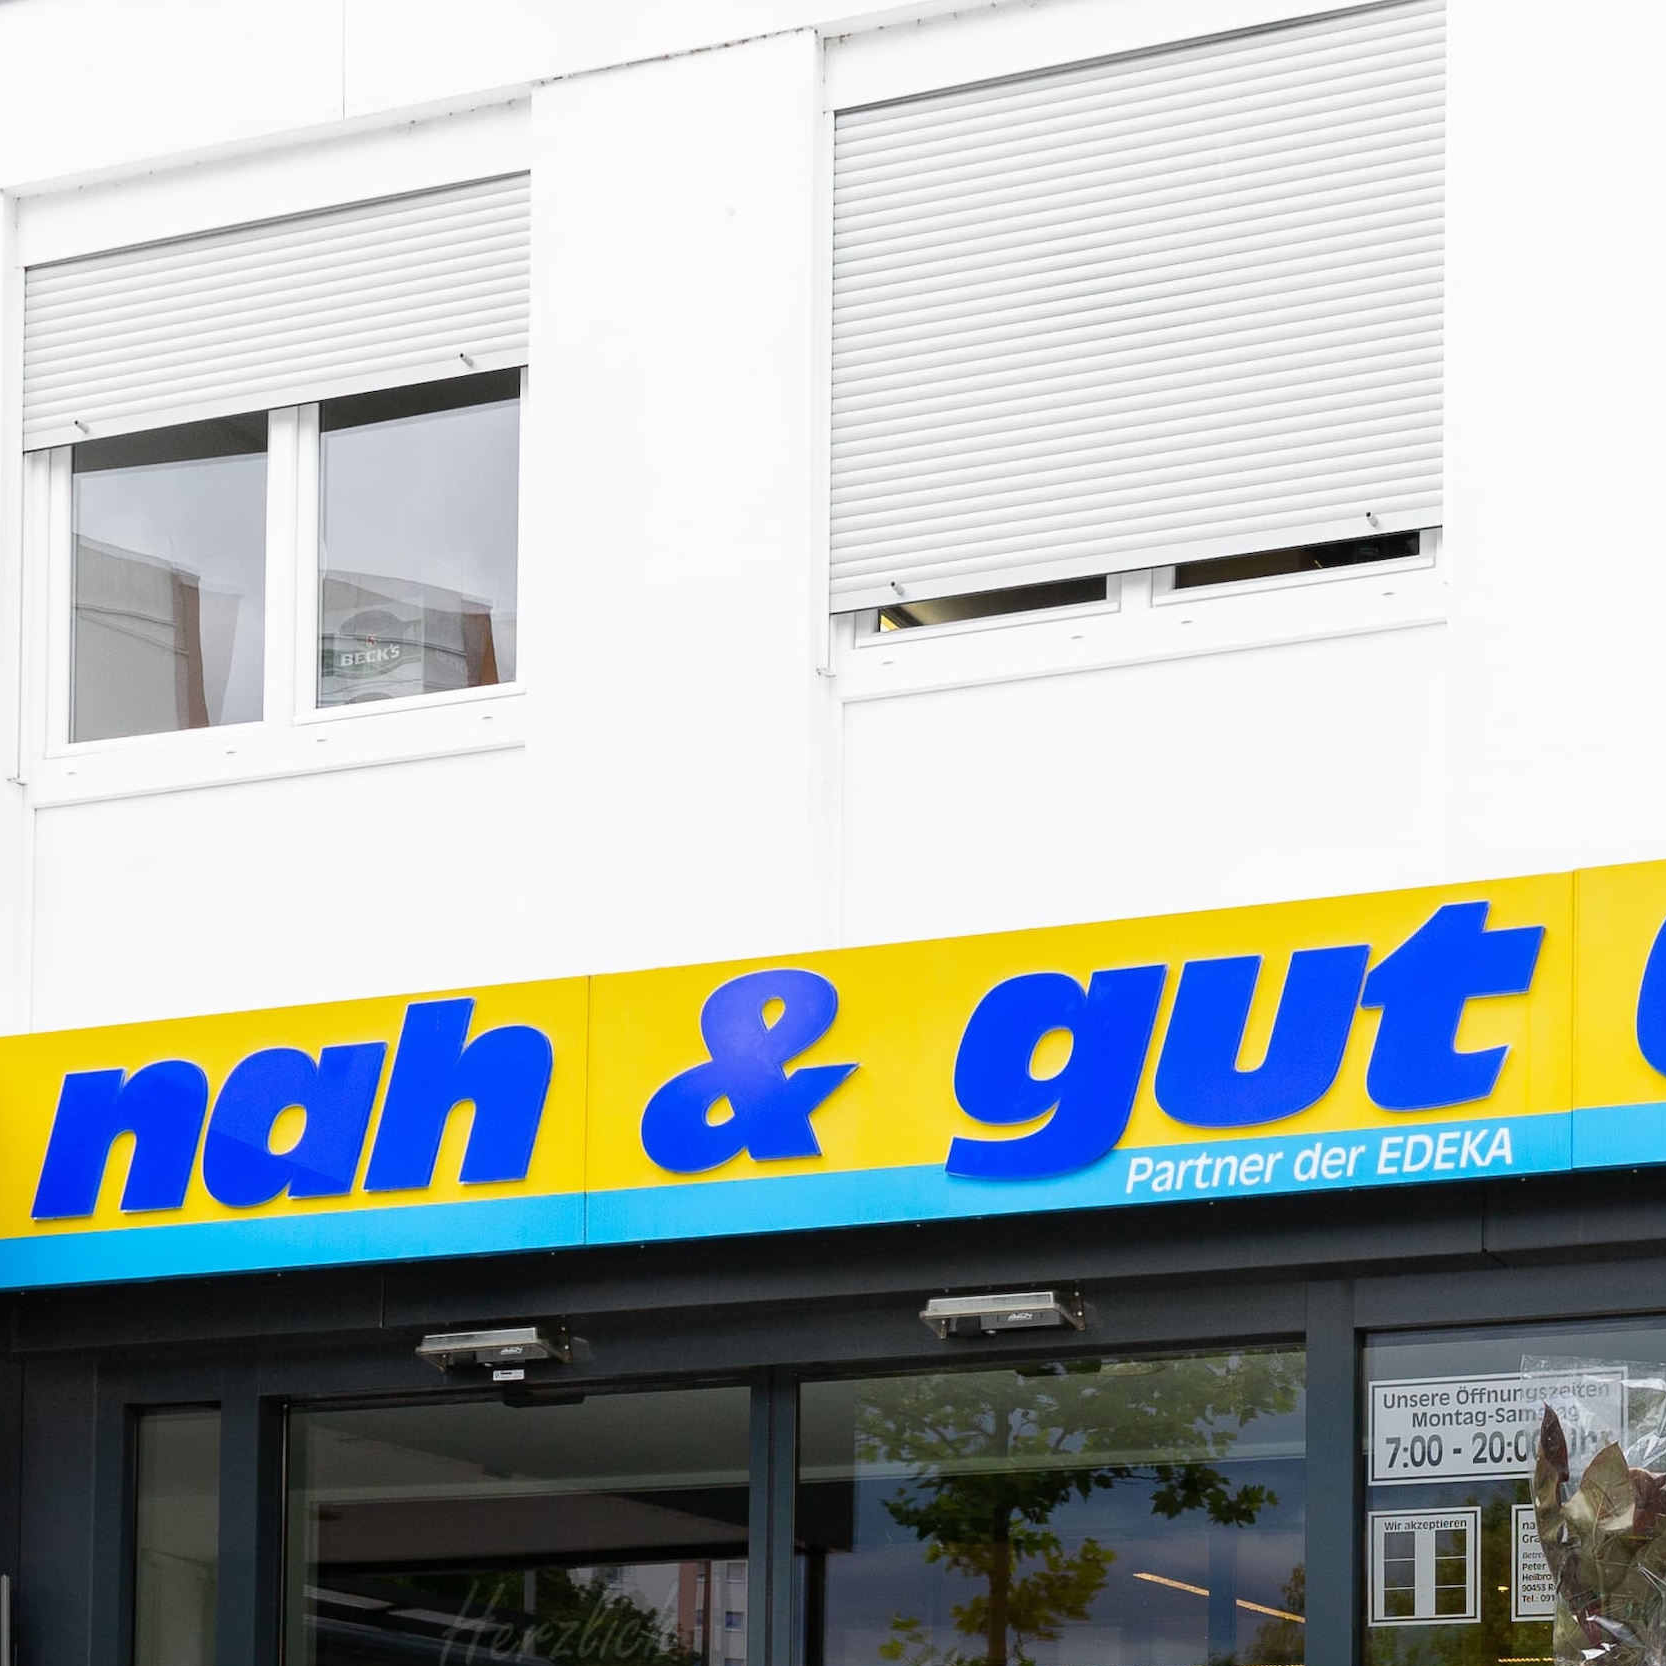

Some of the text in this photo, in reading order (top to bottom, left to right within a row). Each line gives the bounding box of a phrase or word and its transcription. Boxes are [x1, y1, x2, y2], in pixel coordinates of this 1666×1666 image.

[32, 996, 554, 1221] nah
[639, 968, 859, 1176] &
[945, 901, 1546, 1181] gut
[1125, 1127, 1513, 1194] Partner der EDEKA
[1383, 1380, 1610, 1409] Unsere Öffnungszeiten
[1412, 1405, 1580, 1428] Montag-Samag
[1385, 1434, 1443, 1469] 7:00
[1384, 1519, 1467, 1532] Wir akzeptieren
[1522, 1522, 1536, 1530] na
[1522, 1534, 1541, 1544] Gra
[1522, 1562, 1547, 1571] Peter
[1522, 1573, 1552, 1582] Heilbro
[1521, 1584, 1546, 1592] 90453
[1540, 1595, 1555, 1603] 091
